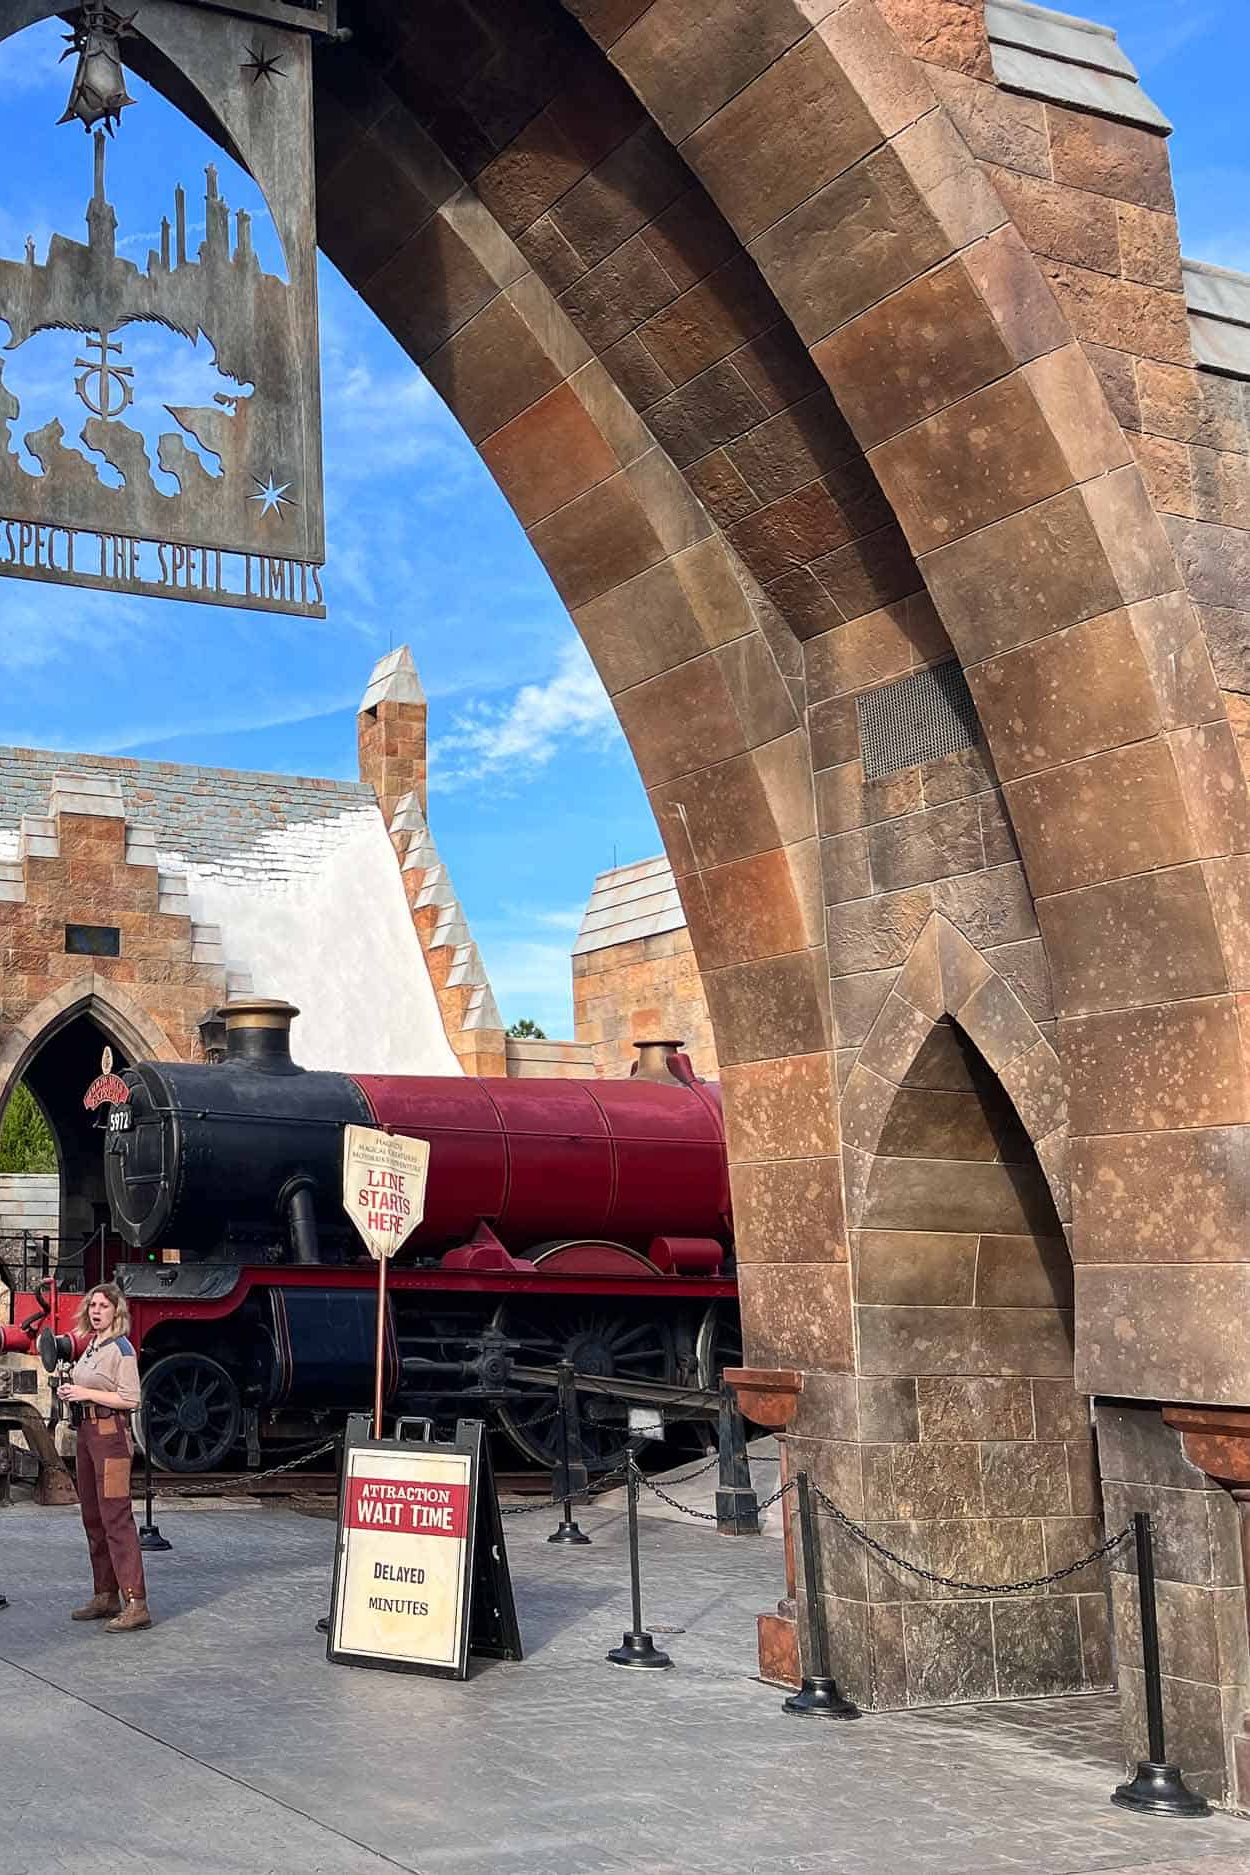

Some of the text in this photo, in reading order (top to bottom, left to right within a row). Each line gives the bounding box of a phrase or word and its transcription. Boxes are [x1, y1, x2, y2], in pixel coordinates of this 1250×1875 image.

[96, 534, 141, 580] THE
[157, 541, 227, 593] SPELL
[246, 554, 323, 606] LIMITS
[110, 1111, 129, 1132] 5972
[367, 1169, 405, 1194] LINE
[358, 1189, 410, 1216] STARTS
[367, 1210, 404, 1236] HERE
[361, 1483, 451, 1503] ATTRACTION
[357, 1499, 454, 1531] WAIT TIME
[373, 1561, 426, 1585] DELAYED
[368, 1596, 429, 1617] MINUTES
